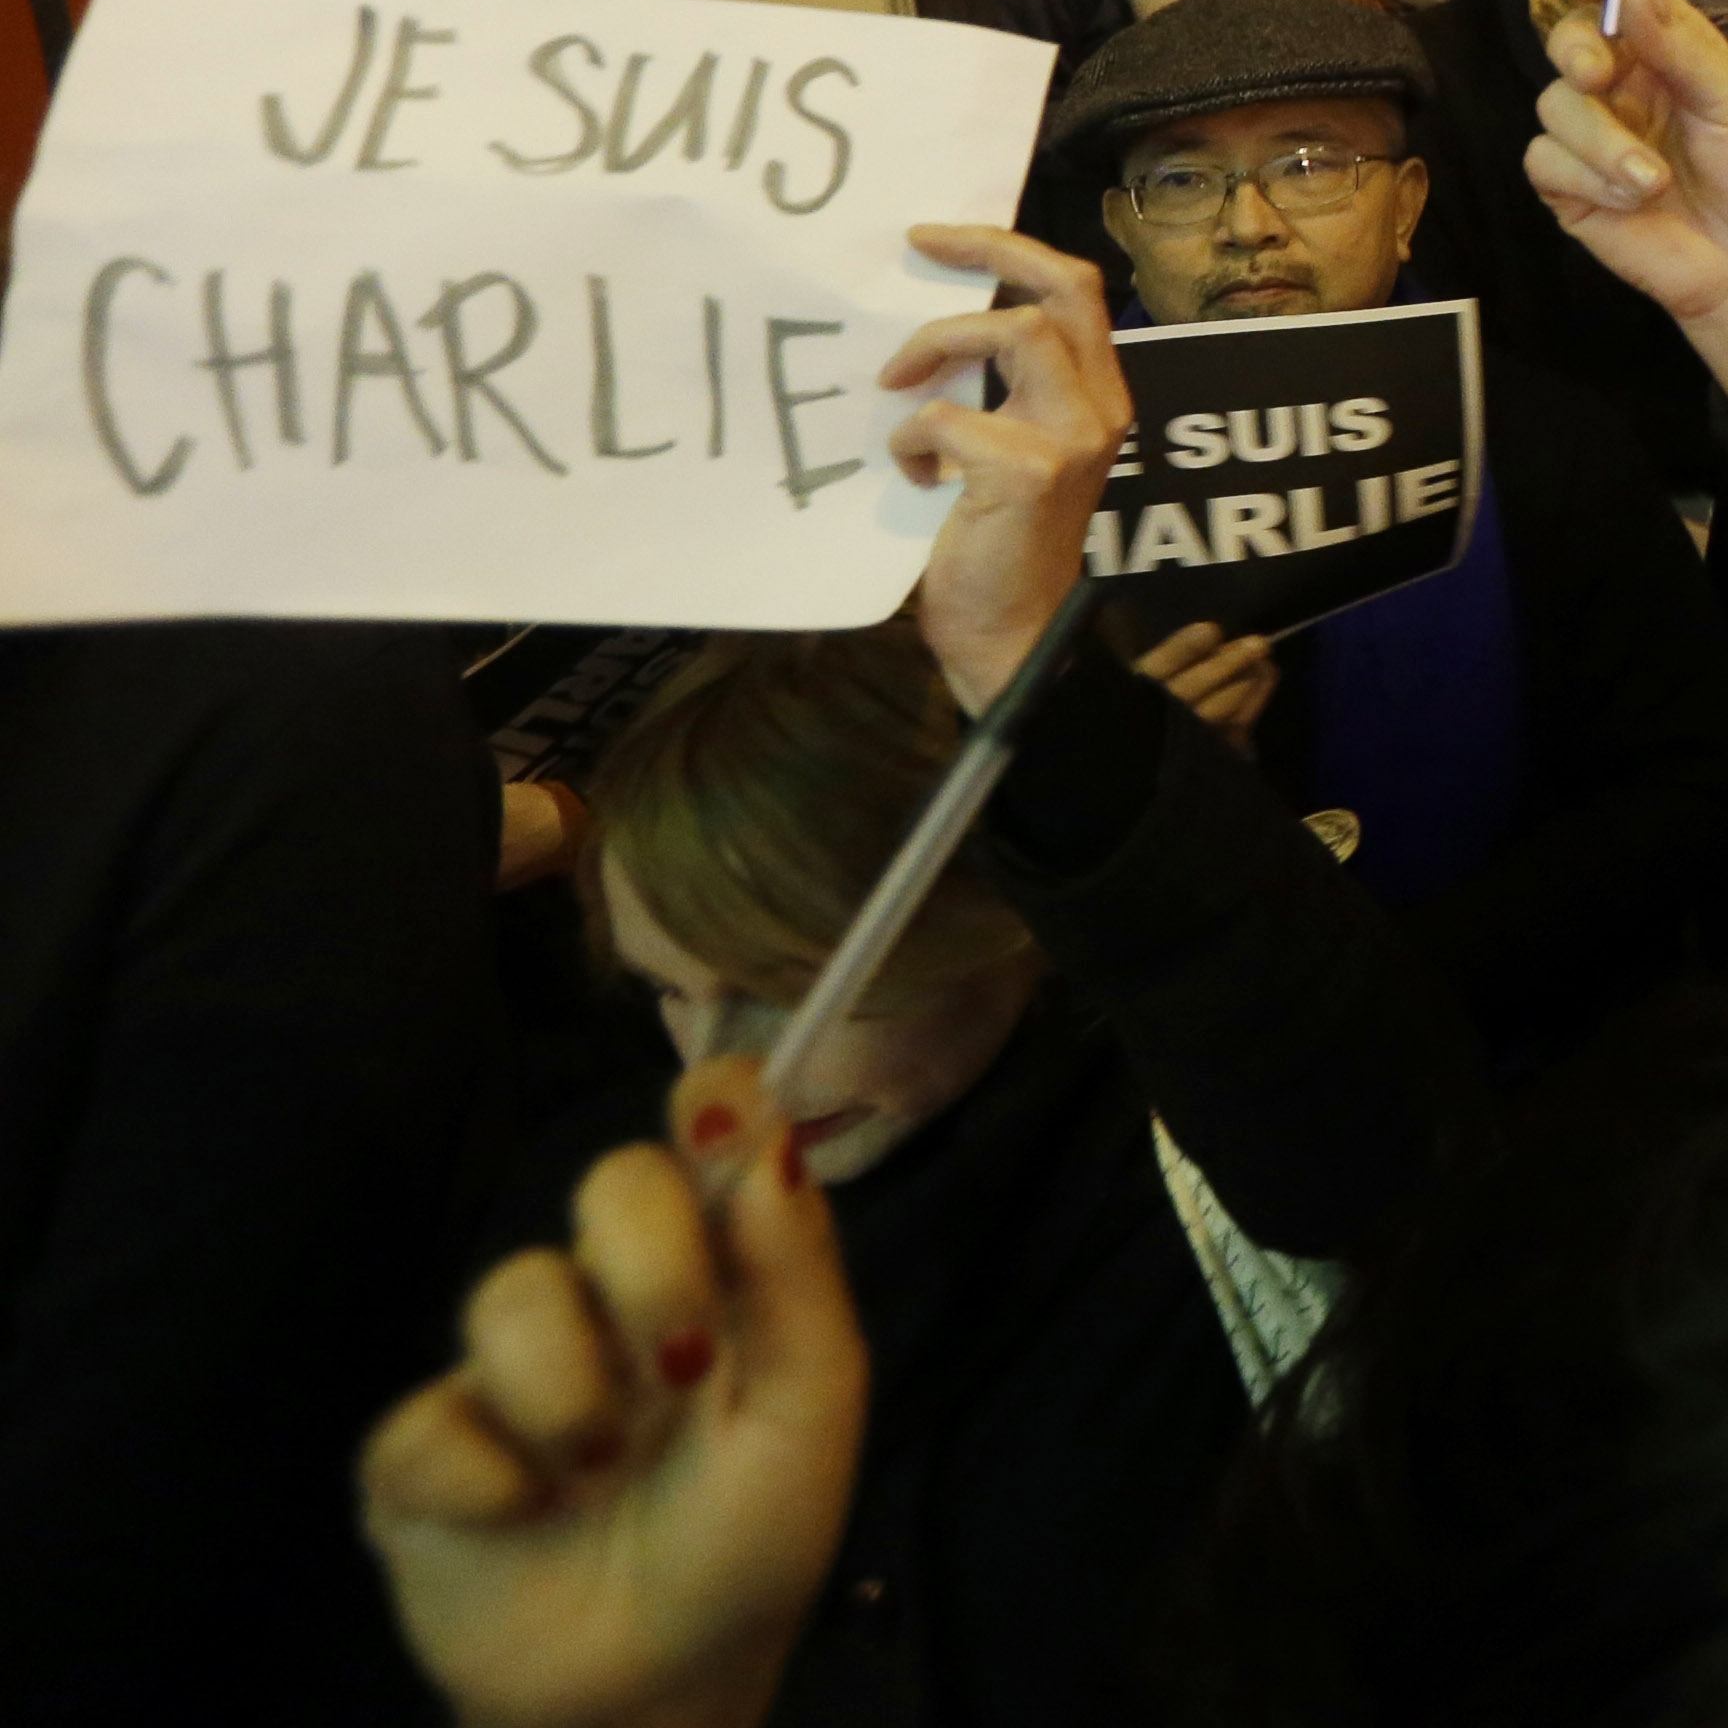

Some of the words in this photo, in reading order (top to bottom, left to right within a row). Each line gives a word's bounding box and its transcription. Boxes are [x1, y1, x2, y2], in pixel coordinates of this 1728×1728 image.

[260, 3, 456, 172] JE
[488, 33, 861, 216] SUIS
[83, 255, 867, 510] CHARLIE
[1106, 421, 1144, 479] E
[1164, 396, 1394, 470] SUIS
[1082, 458, 1461, 577] HARLIE
